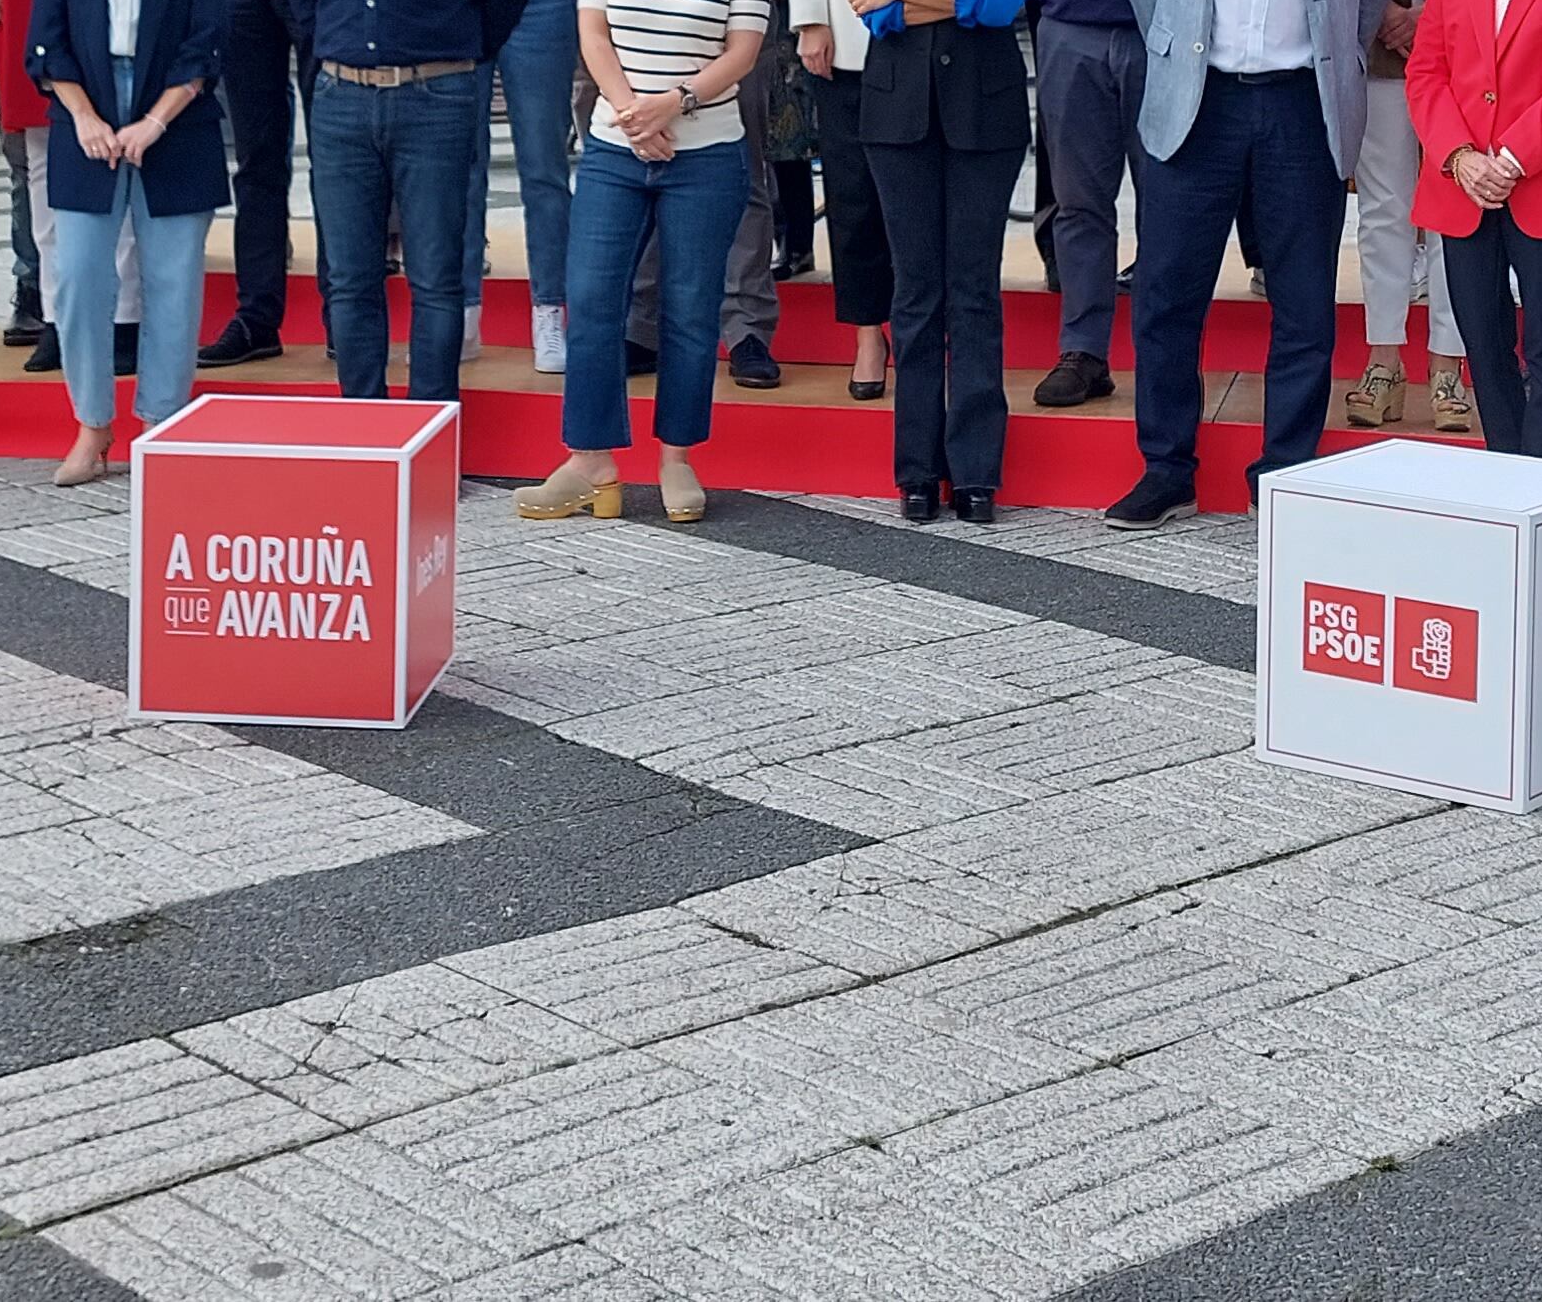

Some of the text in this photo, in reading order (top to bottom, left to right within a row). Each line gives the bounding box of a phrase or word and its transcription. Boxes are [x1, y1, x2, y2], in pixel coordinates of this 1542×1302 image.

[165, 525, 373, 587] A CORUÑA
[164, 590, 372, 642] que AVANZA
[1308, 599, 1358, 632] PSG
[1308, 625, 1381, 667] PSOE
